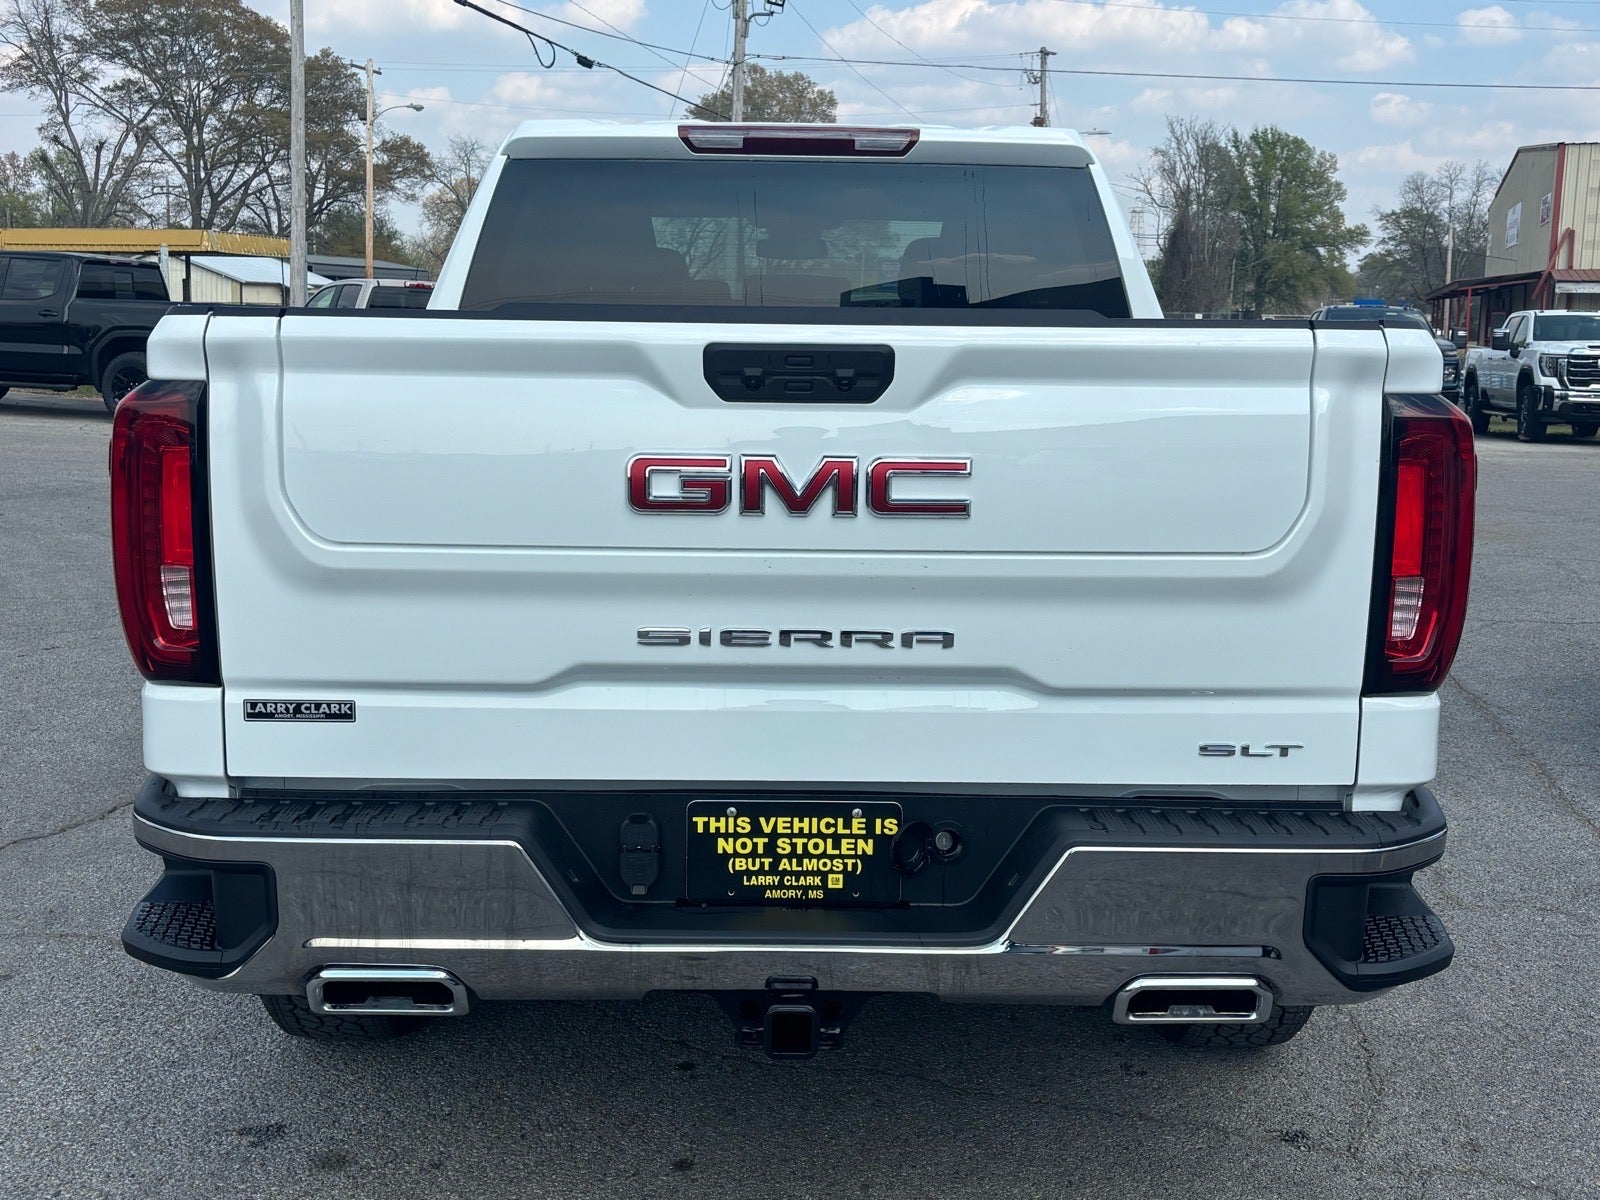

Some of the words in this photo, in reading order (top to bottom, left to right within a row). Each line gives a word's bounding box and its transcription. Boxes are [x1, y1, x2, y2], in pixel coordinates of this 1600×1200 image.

[626, 453, 973, 518] GMC
[636, 626, 955, 649] SIERRA
[246, 702, 297, 714] LARRY
[300, 703, 352, 714] CLARK
[1198, 742, 1304, 757] SLT
[692, 816, 752, 834] THIS
[758, 816, 867, 835] VEHICLE
[875, 818, 899, 836] IS
[716, 837, 769, 855] NOT
[775, 838, 874, 856] STOLEN
[728, 857, 773, 875] (BUT
[778, 858, 863, 875] ALMOST)
[743, 875, 780, 886] LARRY
[784, 876, 822, 886] CLARK
[764, 889, 806, 900] AMORY,
[808, 890, 824, 899] MS
